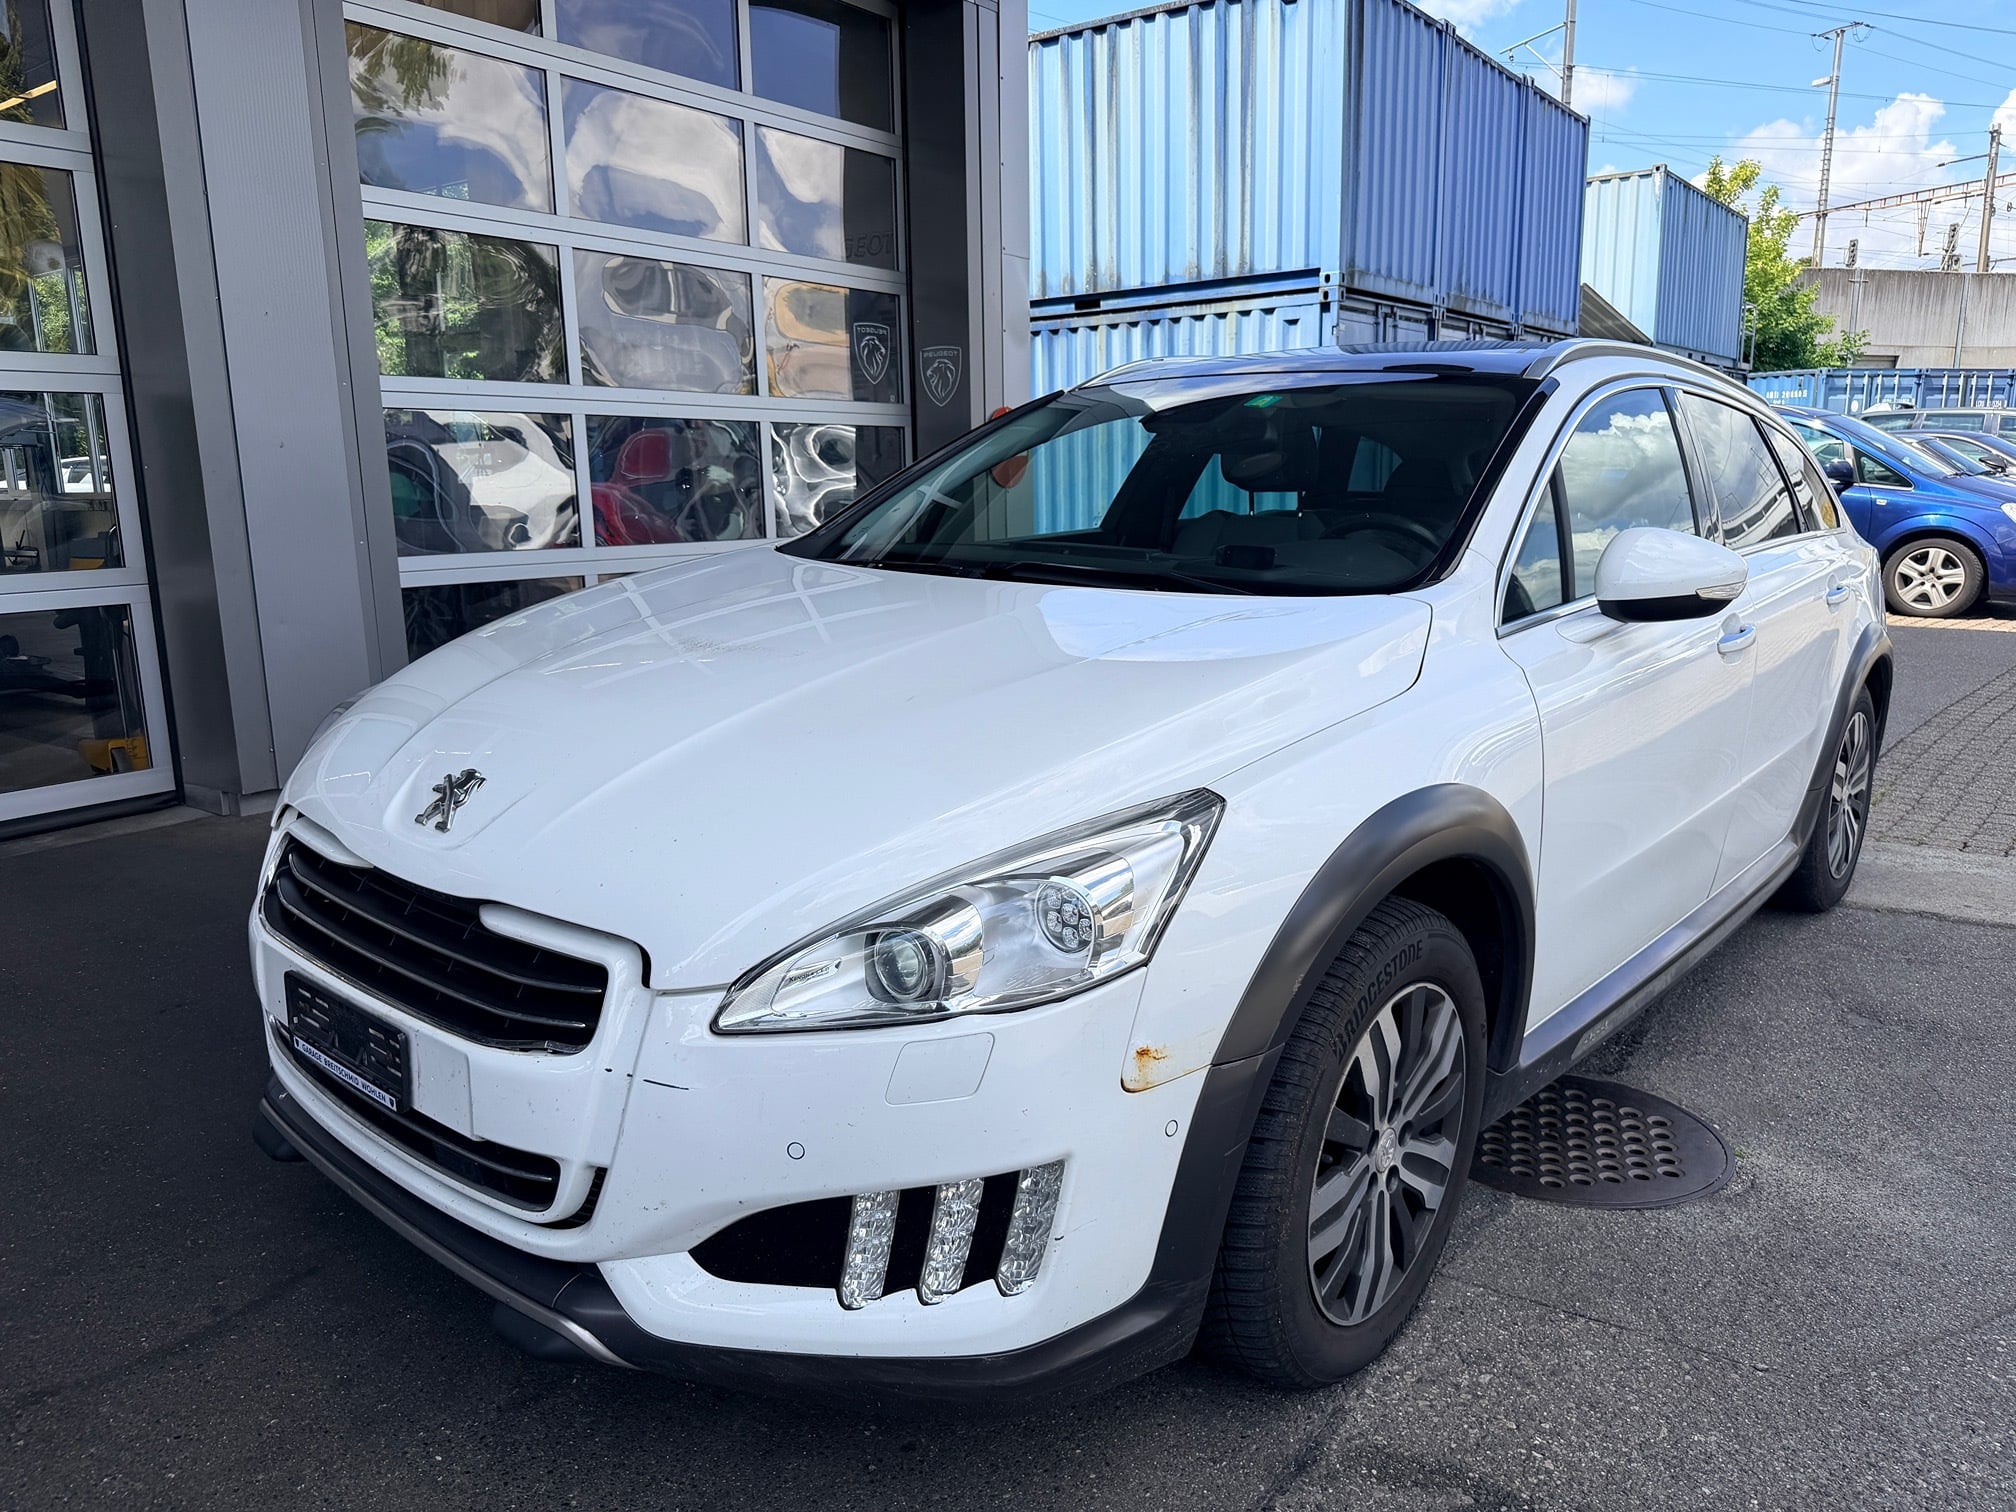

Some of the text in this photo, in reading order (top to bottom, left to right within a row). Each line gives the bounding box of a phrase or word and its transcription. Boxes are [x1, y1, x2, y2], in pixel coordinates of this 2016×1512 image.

[923, 350, 958, 358] PEUGEOT
[1334, 939, 1423, 1063] BRIDGESTONE
[302, 1043, 386, 1103] GARAGE BREITSCHMID WOHLEN
